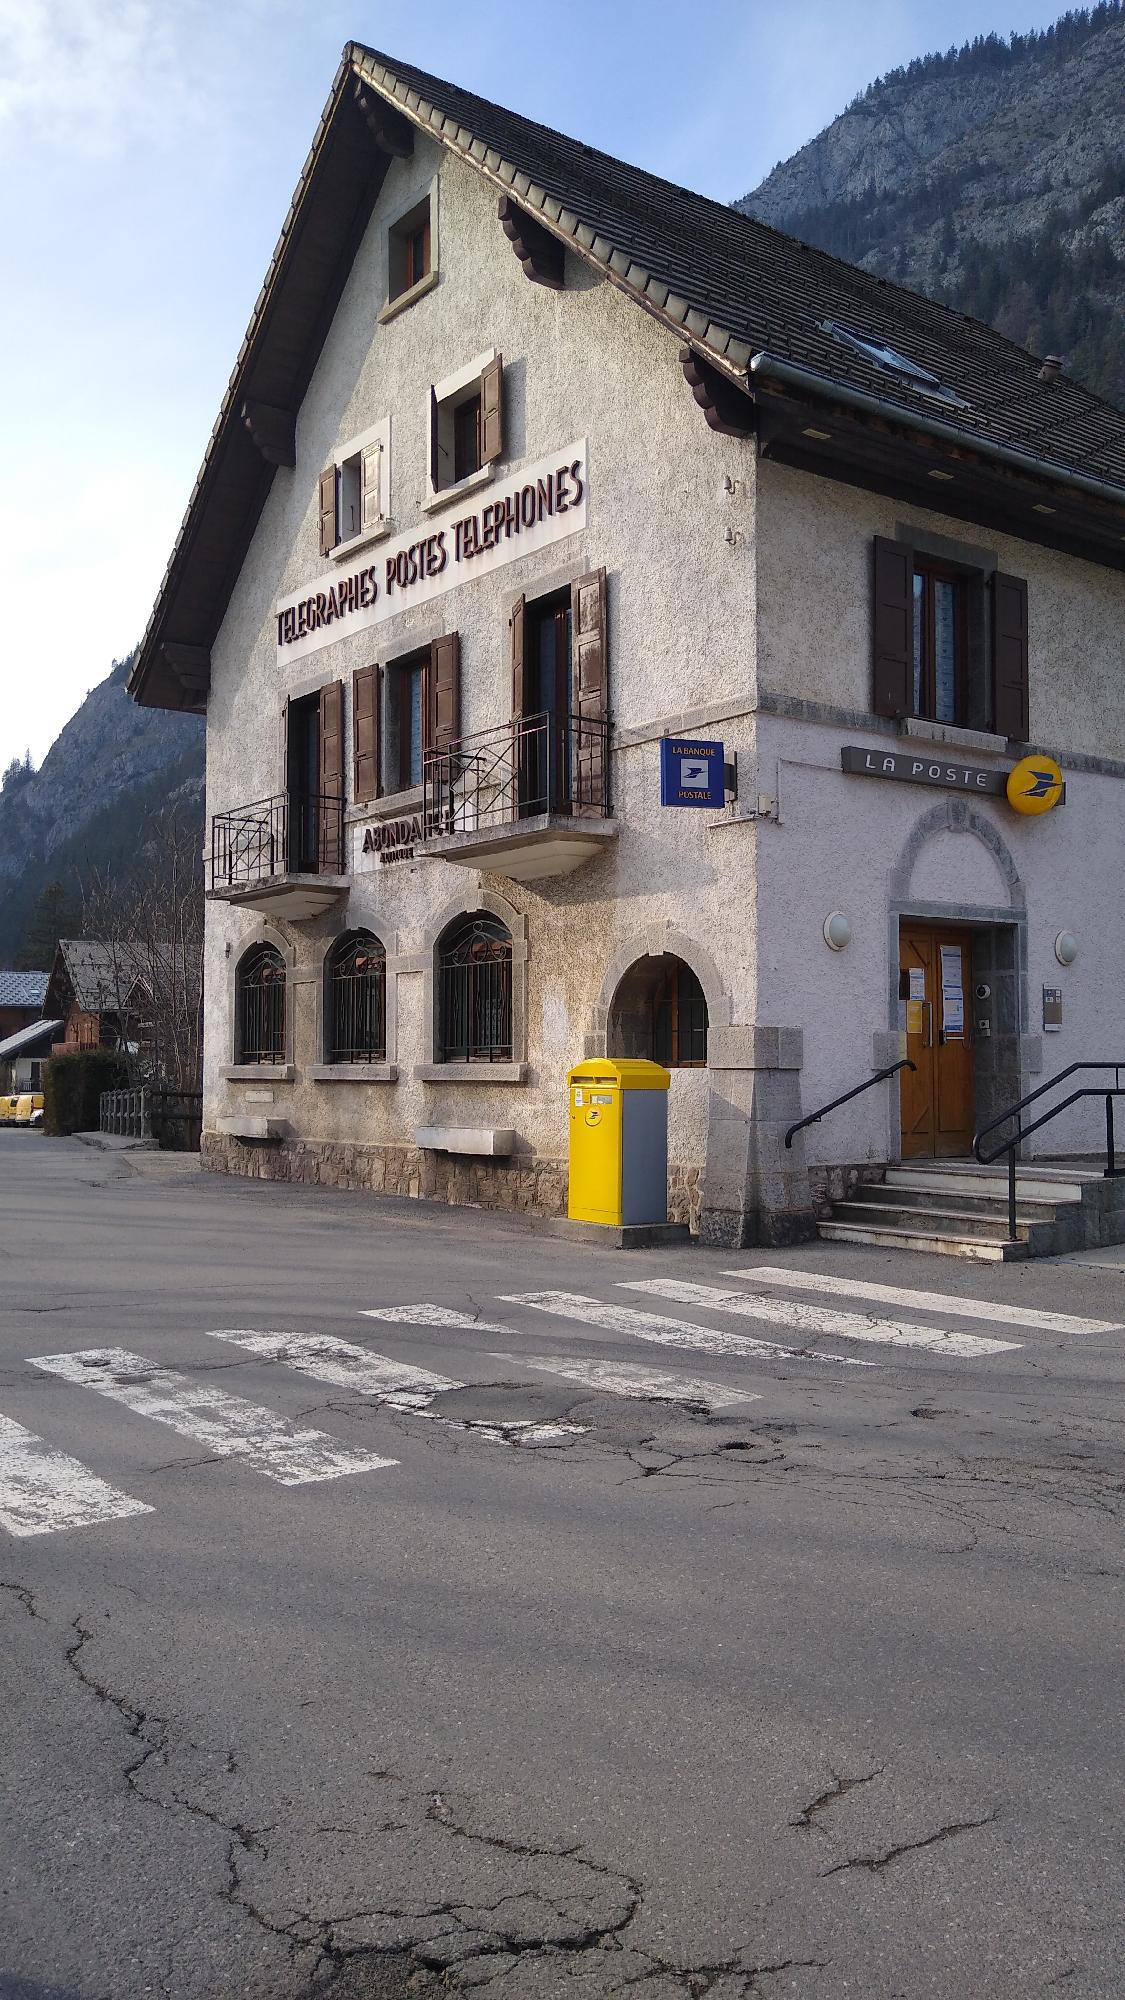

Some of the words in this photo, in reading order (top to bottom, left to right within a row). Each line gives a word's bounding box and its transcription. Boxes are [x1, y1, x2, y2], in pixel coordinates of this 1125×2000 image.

[275, 565, 378, 646] TELEGRAPHES
[385, 531, 447, 595] POSTES
[451, 460, 584, 562] TELEPHONES
[672, 746, 682, 754] LA
[684, 747, 716, 757] BANQUE
[865, 754, 895, 772] LA
[911, 762, 988, 787] POSTE
[678, 791, 712, 800] POSTALE
